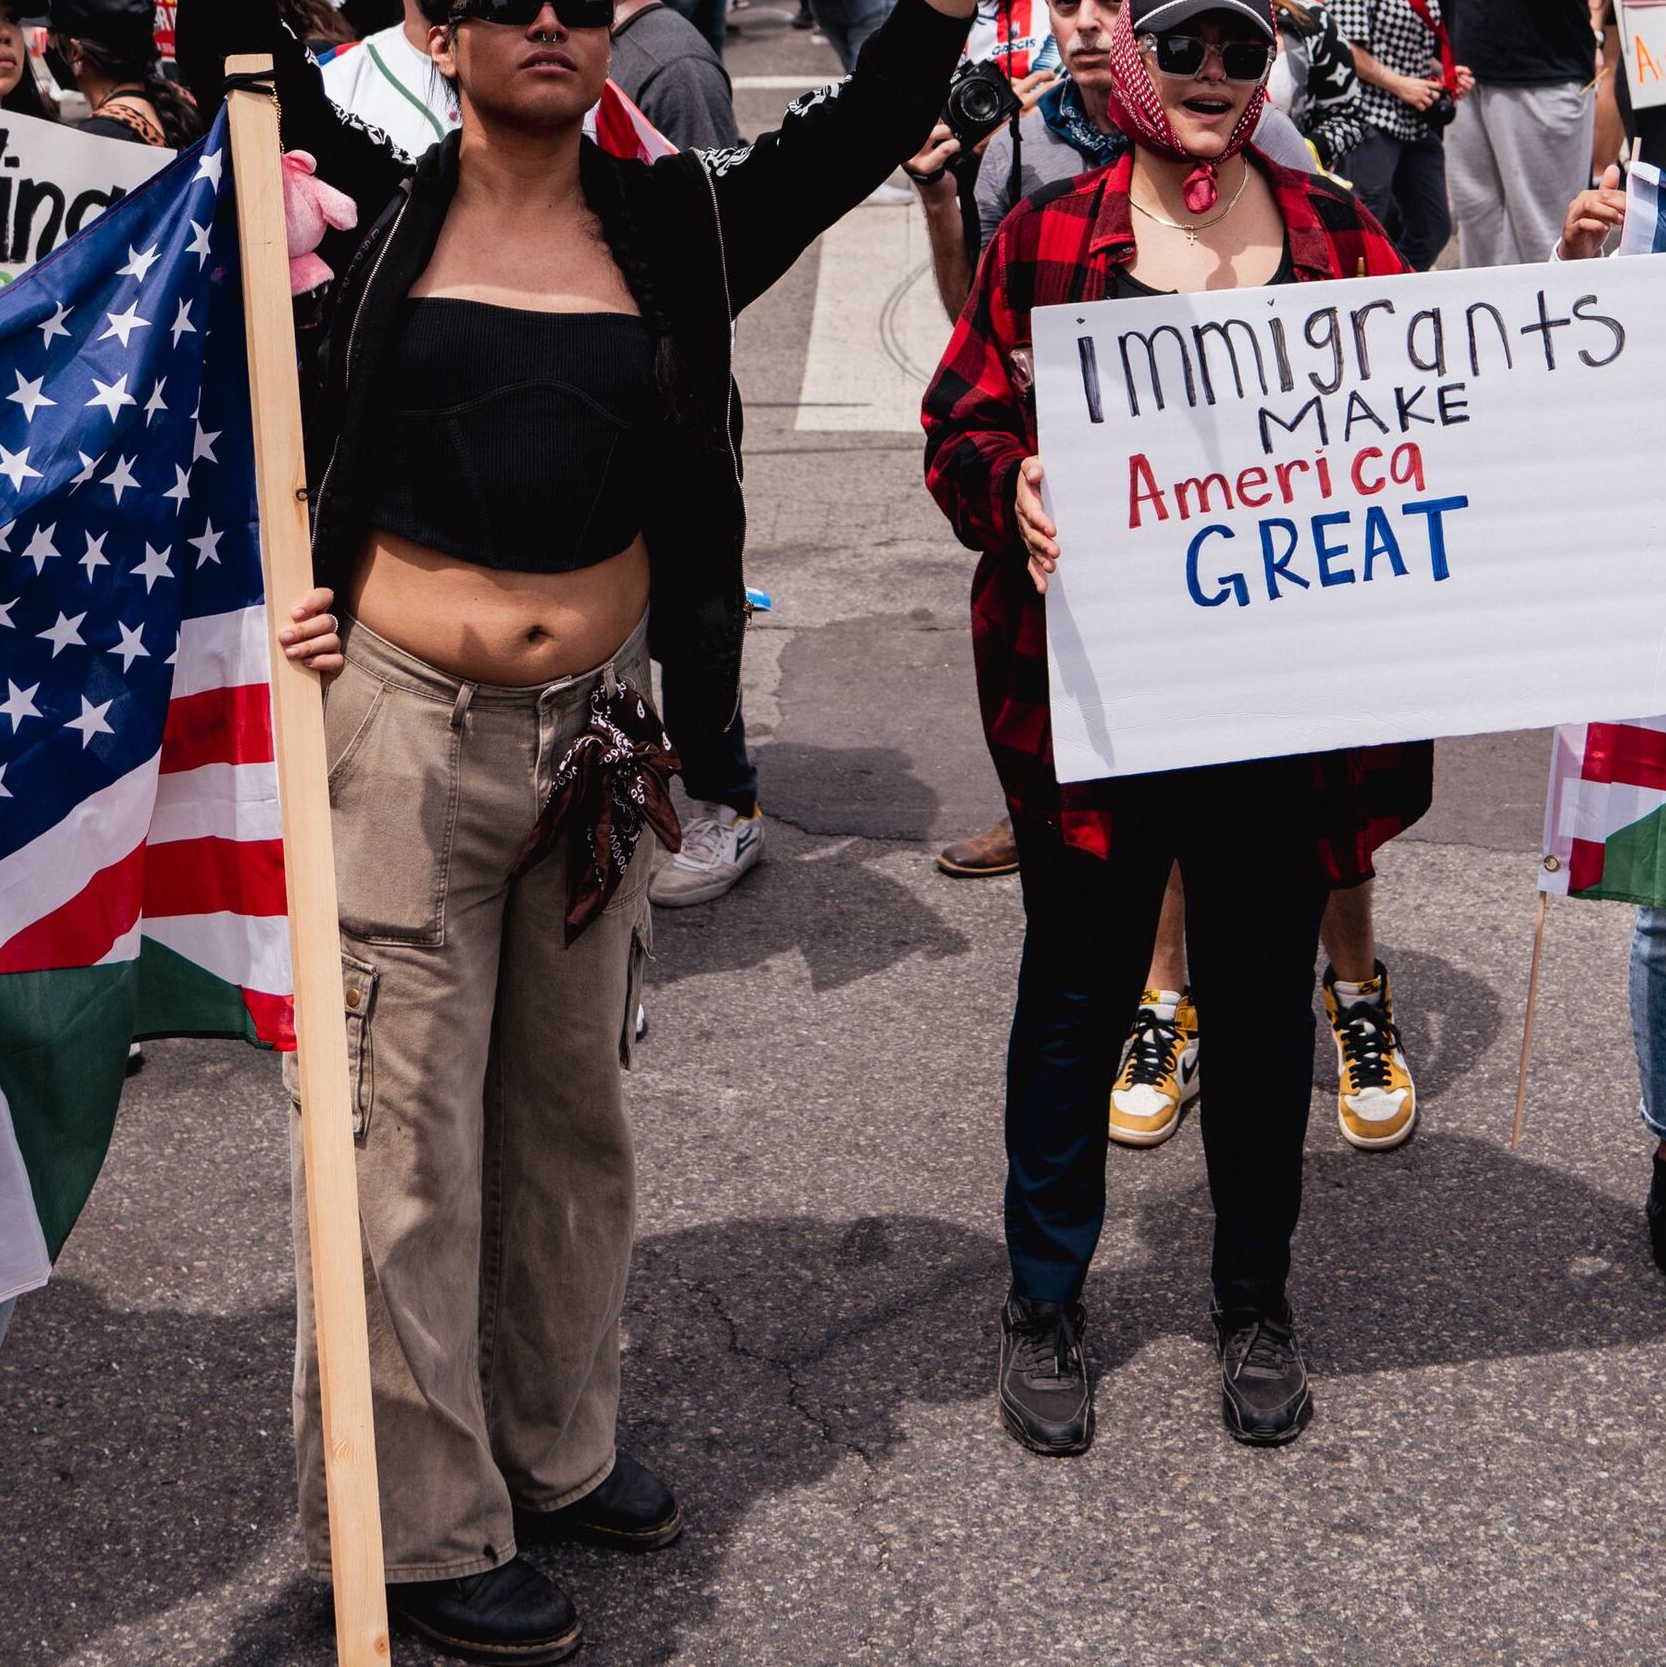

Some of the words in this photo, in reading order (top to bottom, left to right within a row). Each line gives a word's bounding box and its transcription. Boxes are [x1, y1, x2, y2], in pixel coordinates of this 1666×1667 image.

[1259, 382, 1470, 455] MAKE
[1128, 442, 1426, 529] America
[1186, 495, 1469, 607] GREAT
